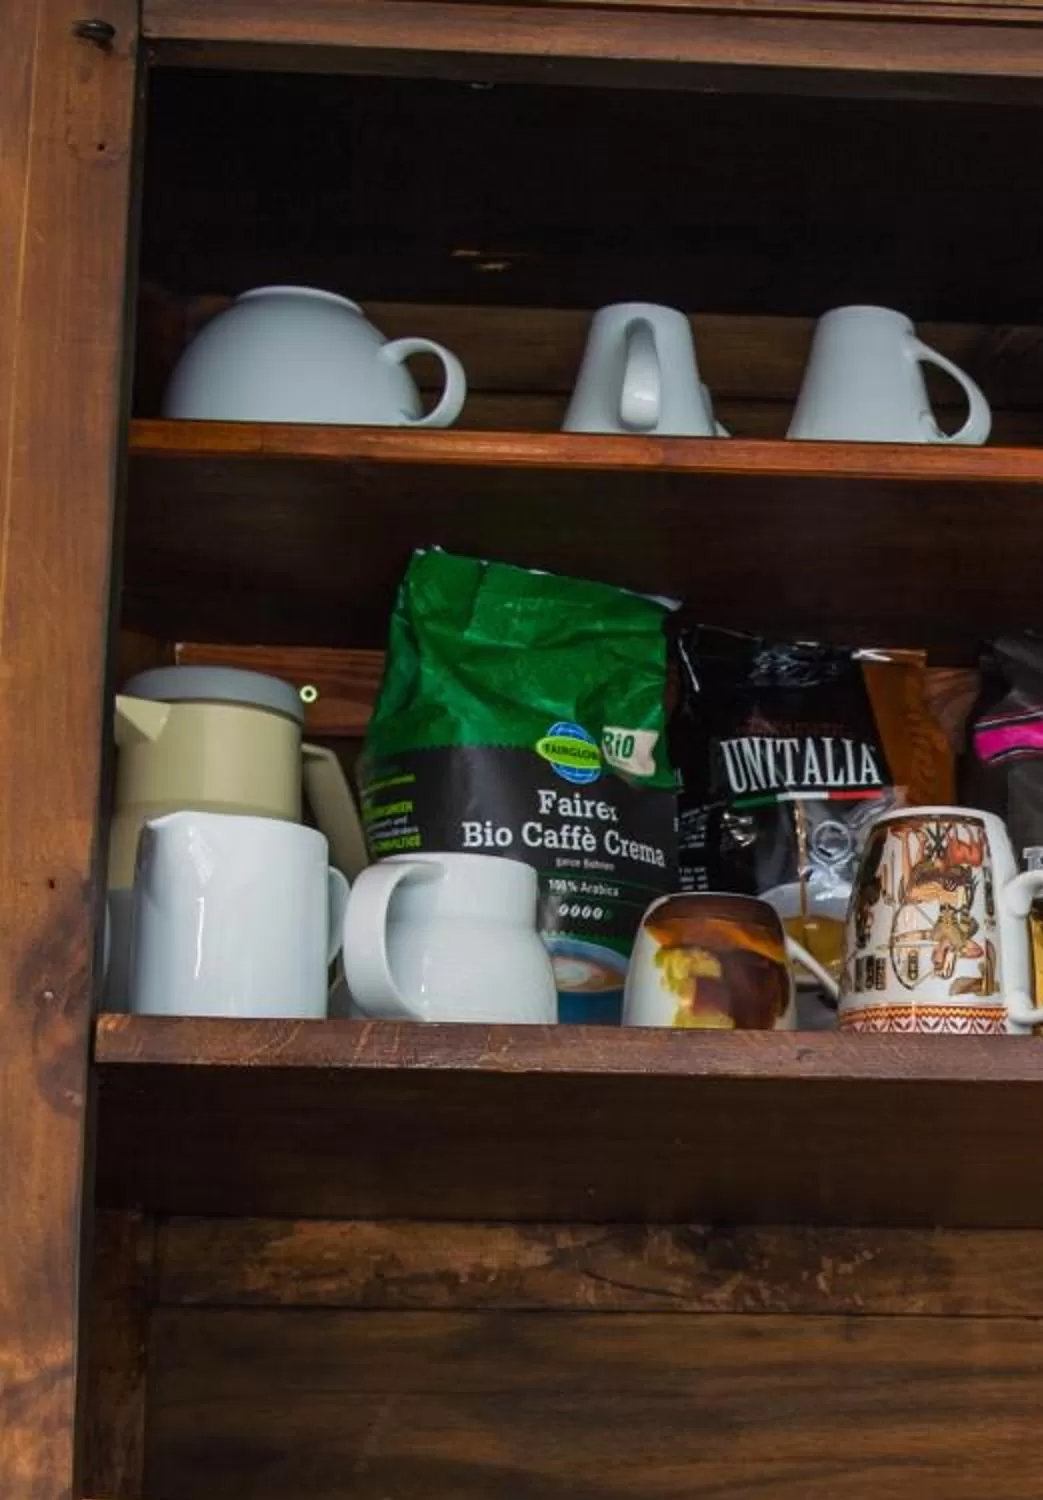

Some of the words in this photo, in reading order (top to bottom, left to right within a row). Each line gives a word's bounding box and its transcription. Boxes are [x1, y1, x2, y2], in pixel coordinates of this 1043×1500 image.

[720, 736, 883, 793] UNITALIA
[462, 821, 513, 847] Bio
[522, 821, 597, 852] Caffè
[604, 829, 667, 868] Crema
